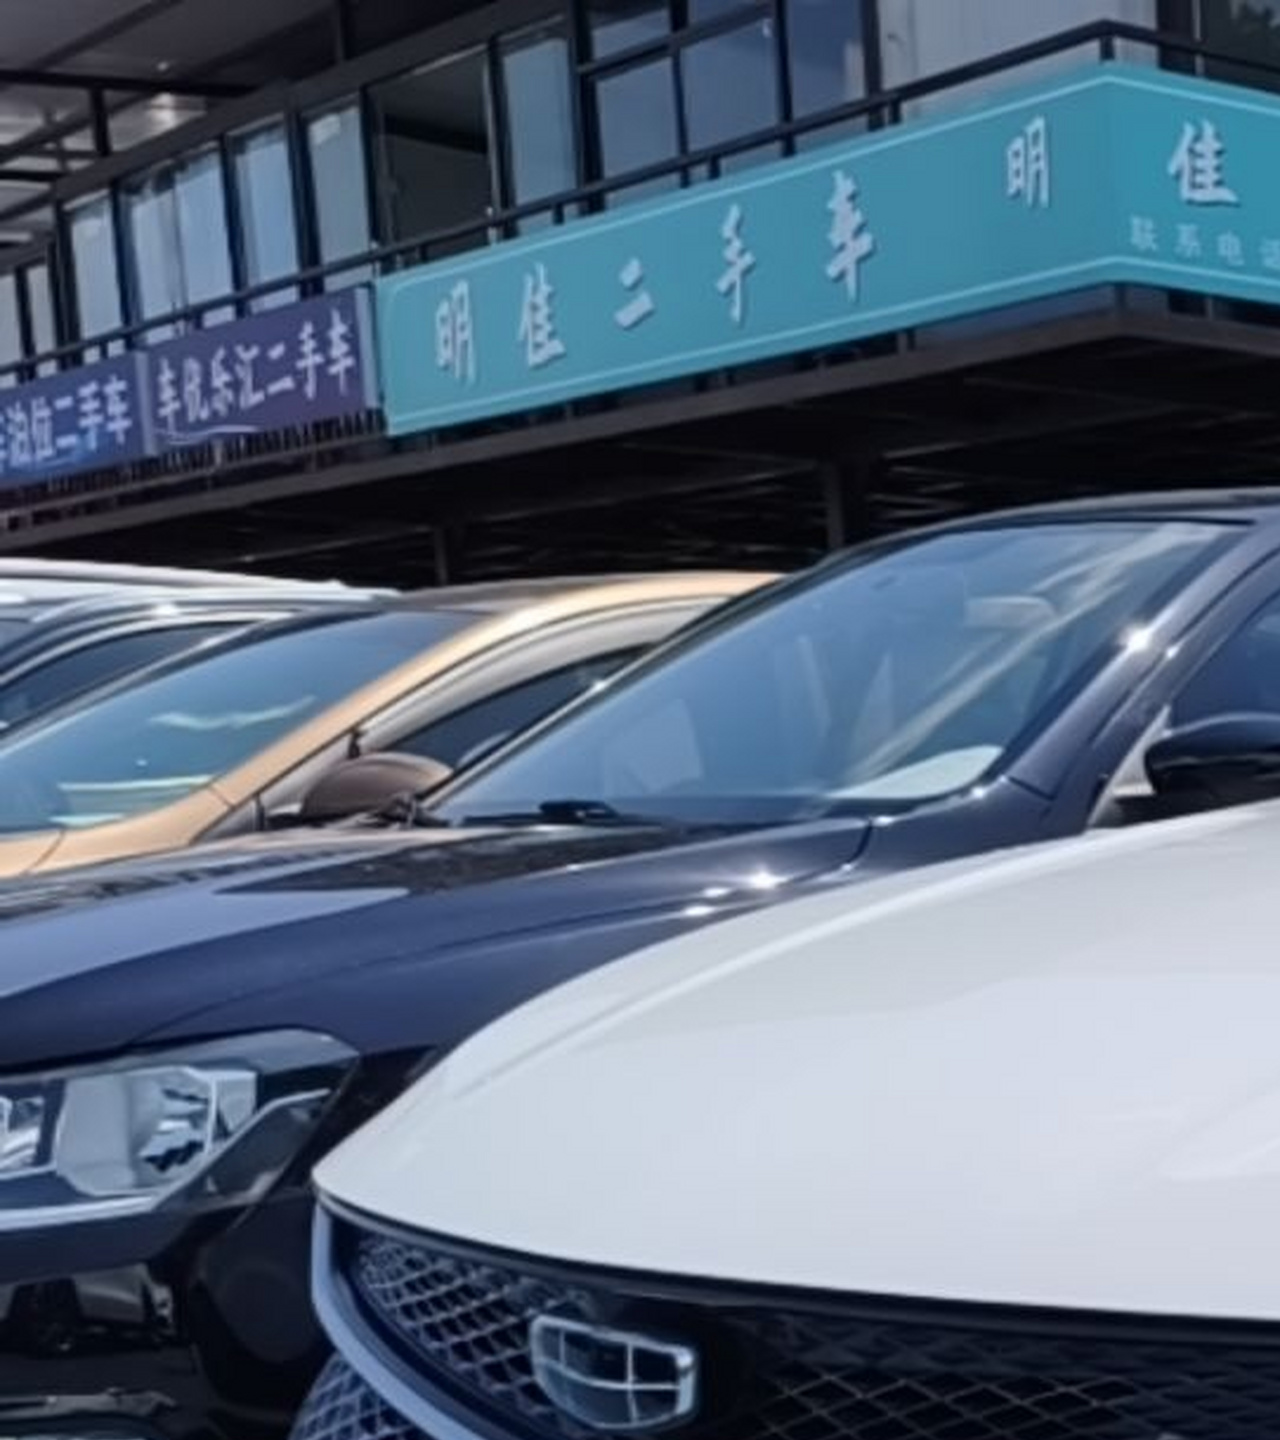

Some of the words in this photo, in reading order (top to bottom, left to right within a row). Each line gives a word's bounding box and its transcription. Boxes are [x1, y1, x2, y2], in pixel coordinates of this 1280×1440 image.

[435, 170, 874, 383] 明佳二手车
